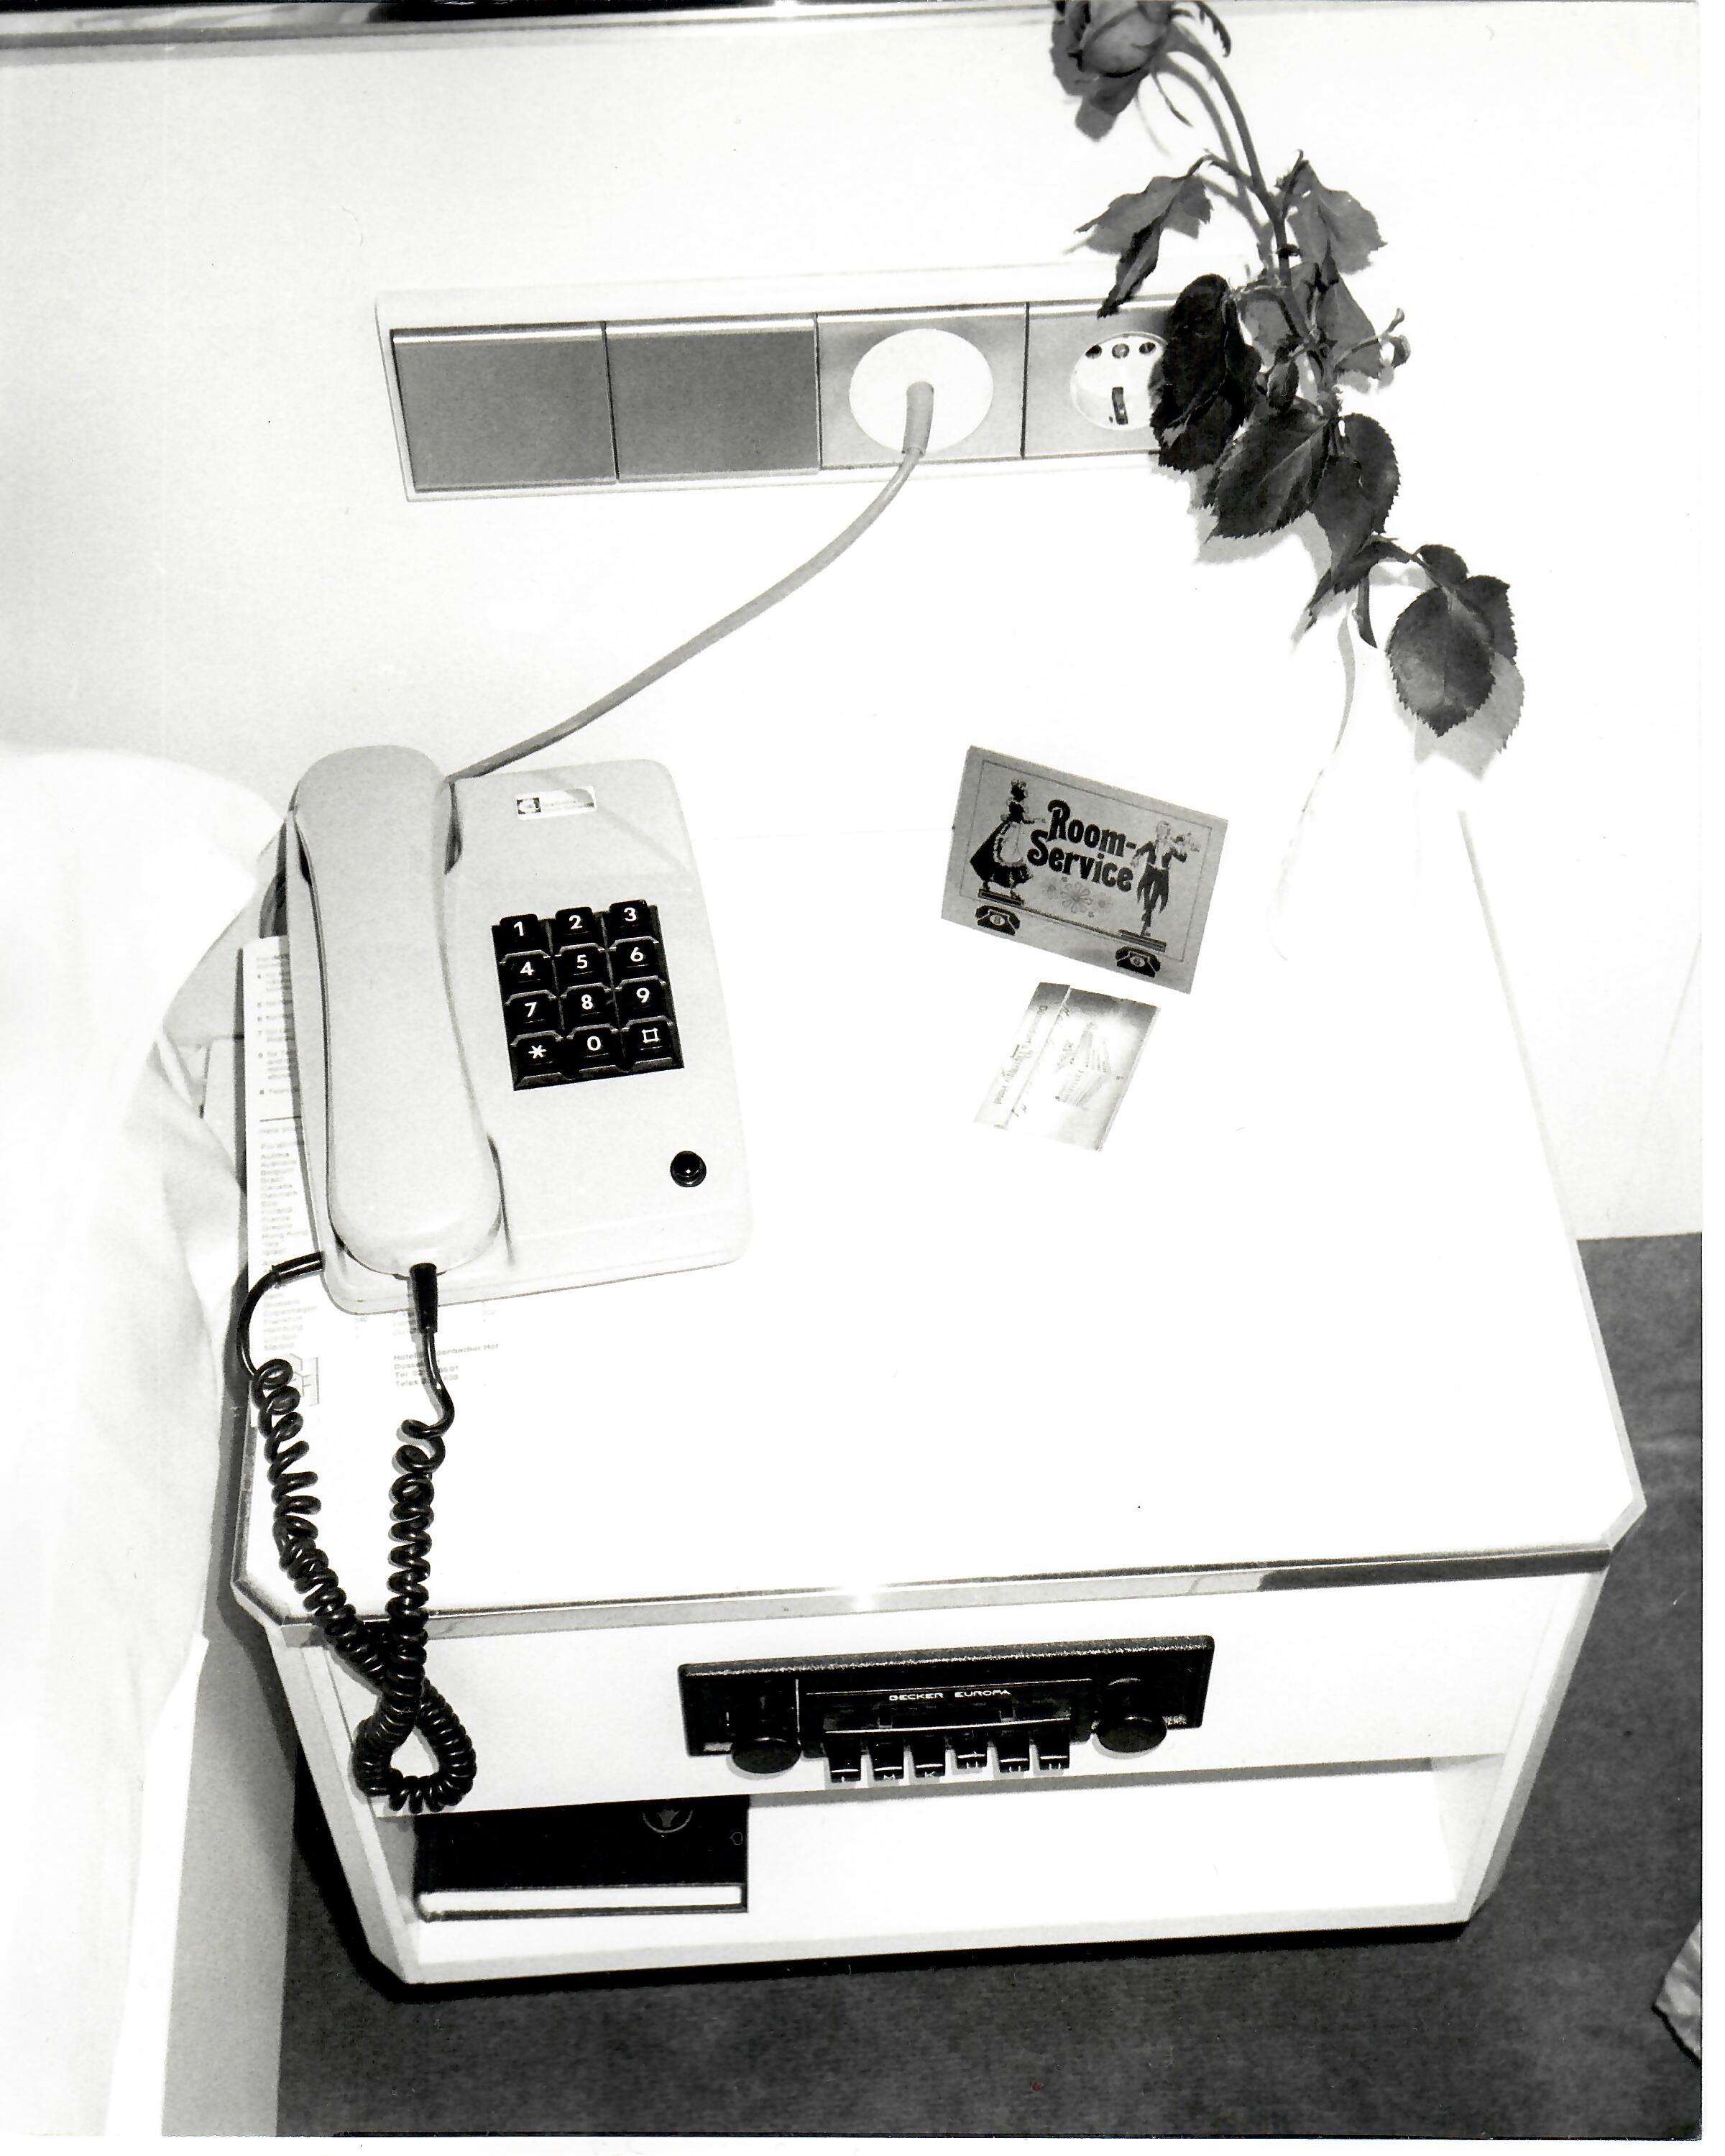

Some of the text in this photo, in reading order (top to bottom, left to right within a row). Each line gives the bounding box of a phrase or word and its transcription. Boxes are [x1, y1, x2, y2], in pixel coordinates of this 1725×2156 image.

[1046, 799, 1137, 857] Room-
[1026, 829, 1133, 892] Service
[514, 908, 637, 936] 1 2 3
[520, 947, 643, 975] 4 5 6
[525, 987, 650, 1017] 7 8 9
[587, 1036, 601, 1051] 0
[889, 1689, 1011, 1701] BECKER EUROPA
